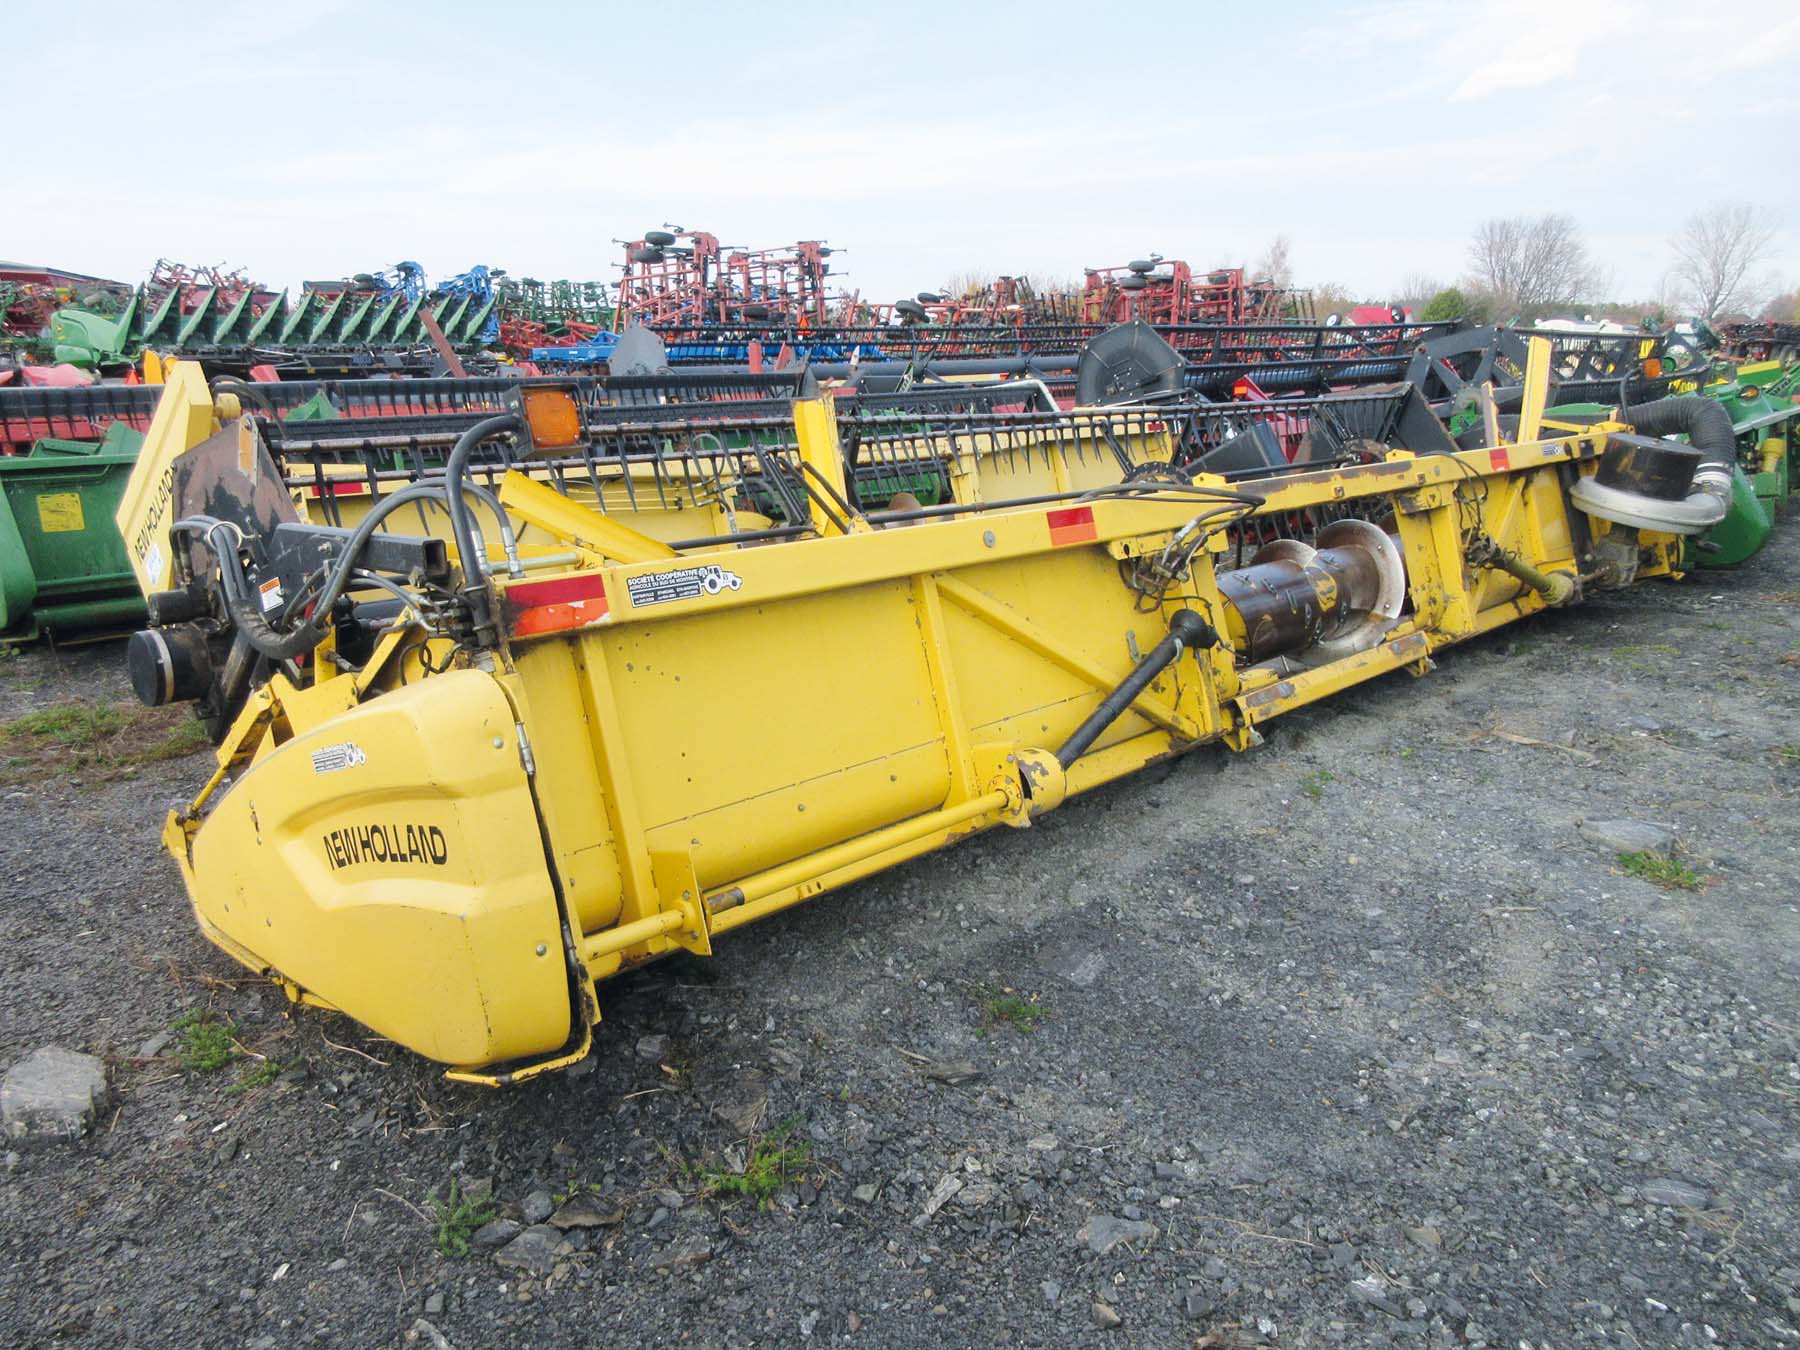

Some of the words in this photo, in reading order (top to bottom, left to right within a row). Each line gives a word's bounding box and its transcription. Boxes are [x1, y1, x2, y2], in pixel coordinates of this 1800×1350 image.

[145, 468, 174, 540] HOLLAND
[627, 574, 655, 586] SOCIÉTÉ
[656, 569, 698, 581] COOPÉRATIVE
[323, 826, 360, 870] NEW
[357, 824, 447, 865] HOLLAND
